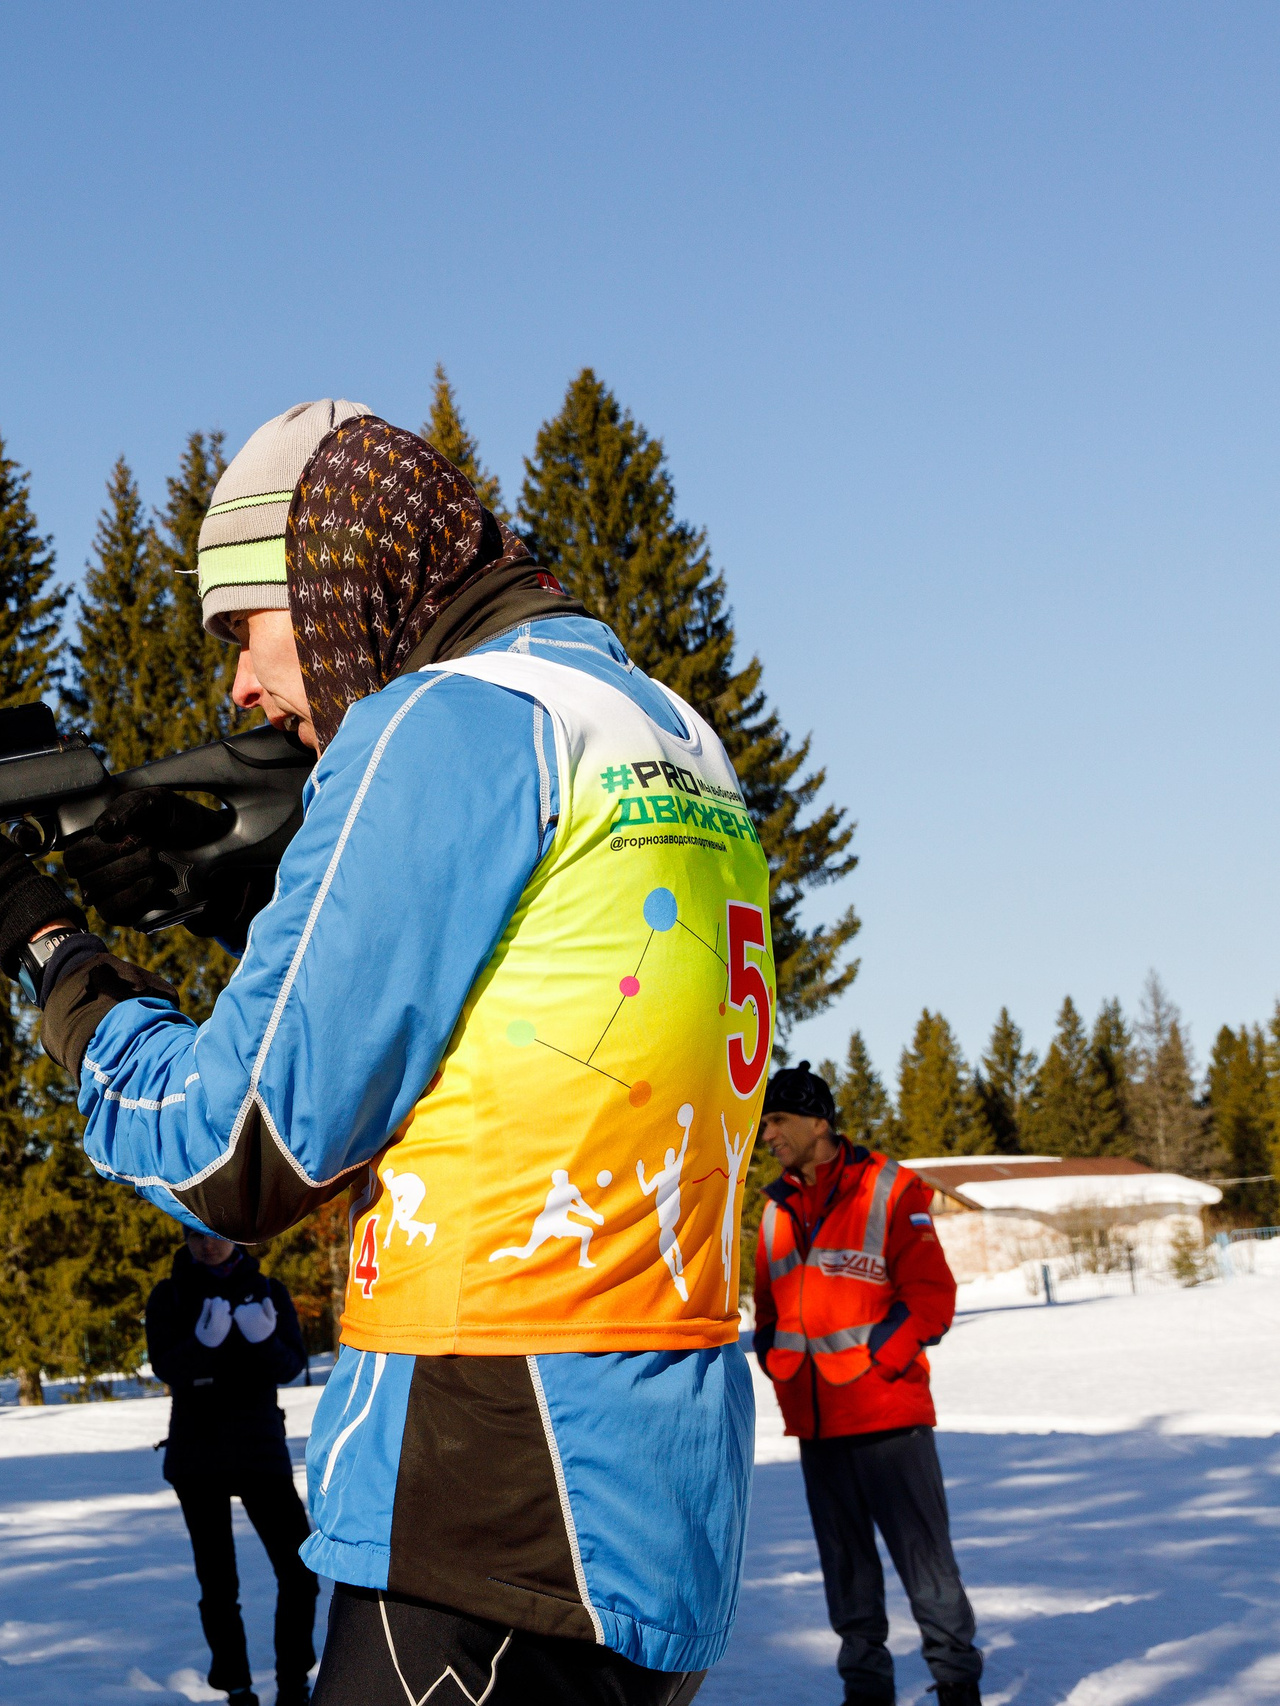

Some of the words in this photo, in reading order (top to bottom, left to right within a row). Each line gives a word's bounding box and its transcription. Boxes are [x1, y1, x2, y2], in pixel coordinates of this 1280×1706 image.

[599, 760, 702, 797] #PRO
[726, 899, 771, 1100] 5
[354, 1214, 381, 1299] 4
